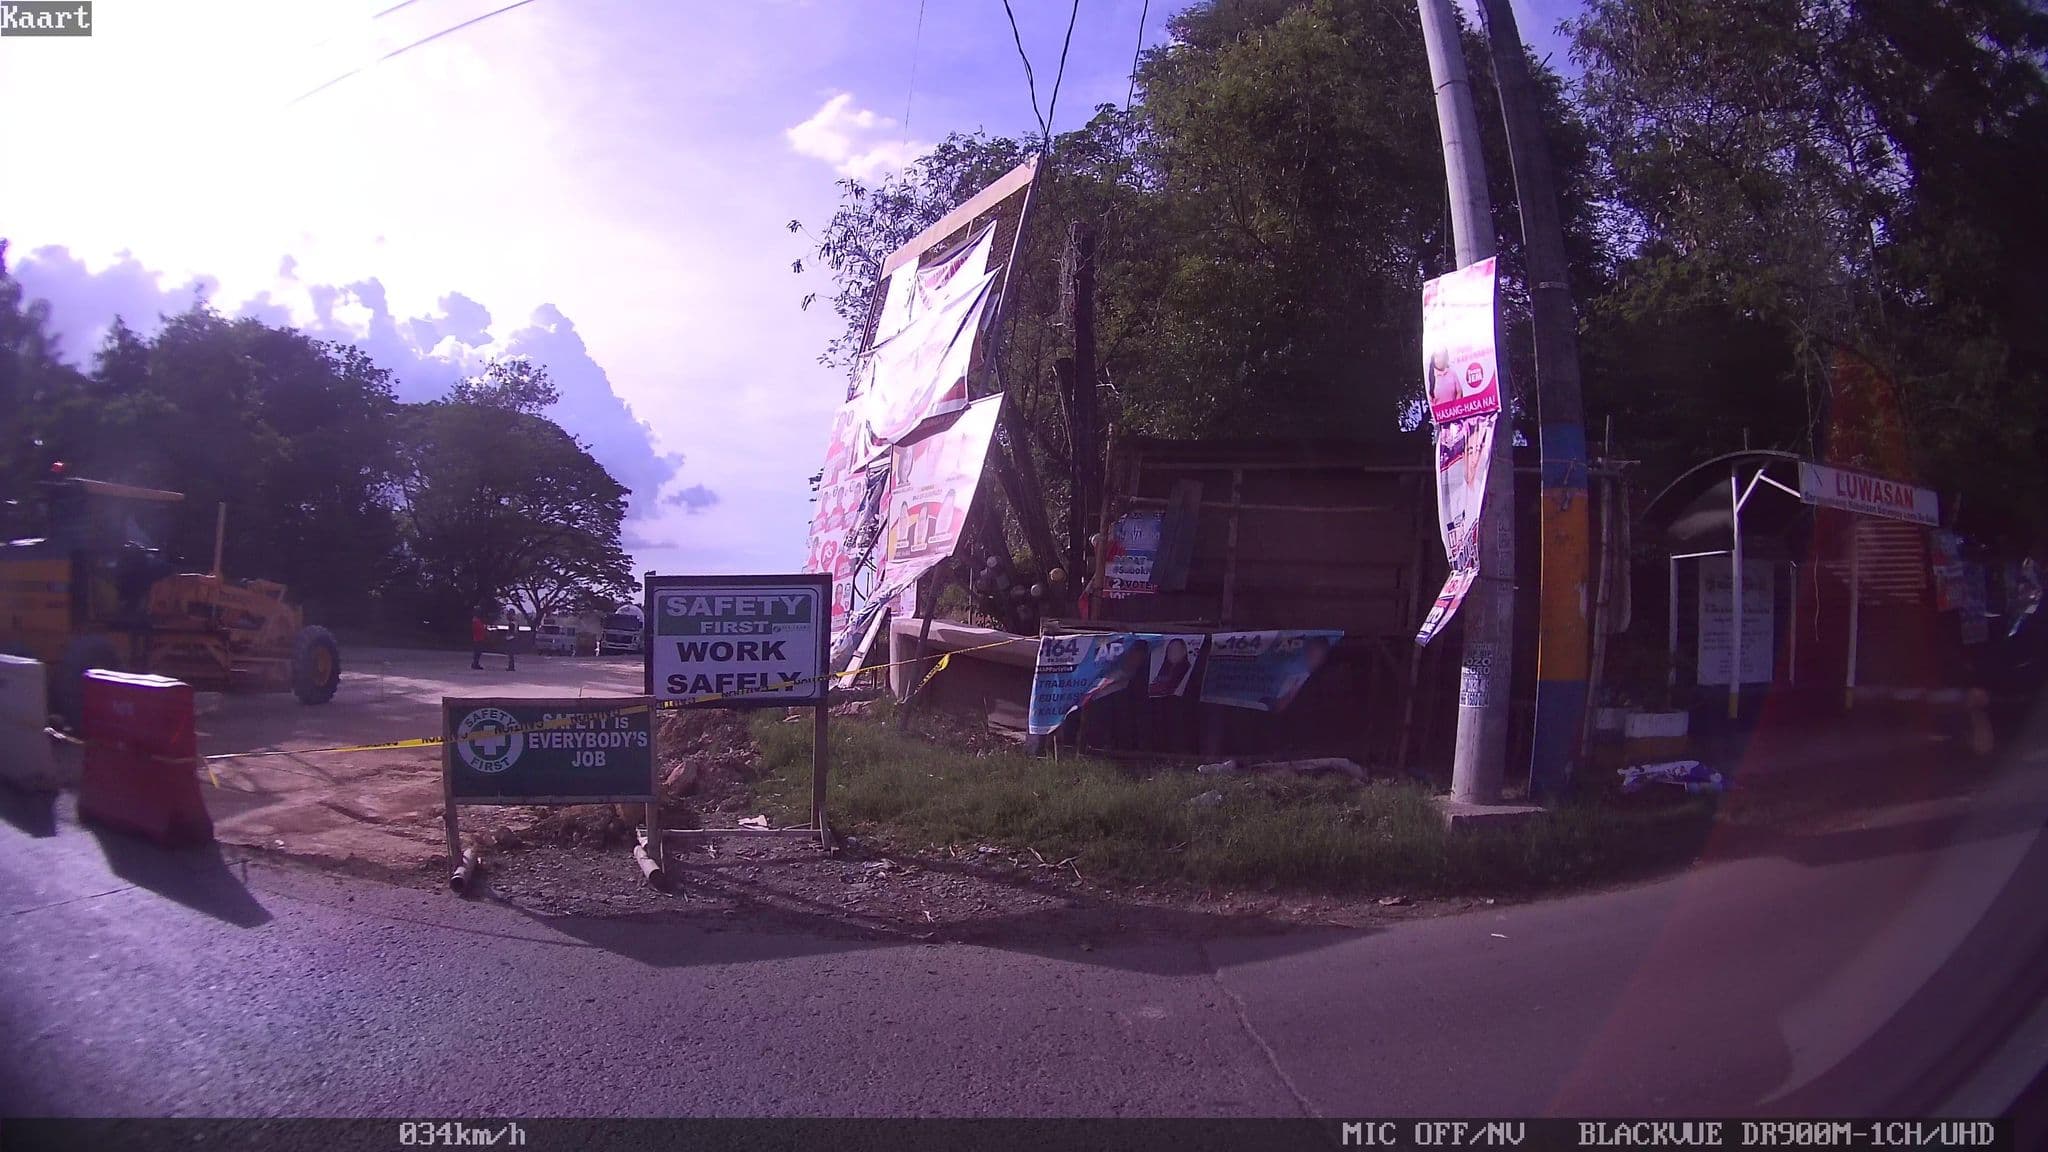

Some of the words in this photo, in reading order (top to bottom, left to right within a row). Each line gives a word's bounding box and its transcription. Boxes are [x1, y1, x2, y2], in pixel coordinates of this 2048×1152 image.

[1835, 472, 1914, 509] LUWASAN
[666, 596, 805, 617] SAFETY
[700, 621, 769, 634] FIRST
[676, 640, 786, 662] WORK
[1043, 638, 1079, 657] 164
[1464, 657, 1491, 666] OZO
[1462, 666, 1490, 675] EGRO
[667, 672, 802, 695] SAFELY
[1039, 678, 1087, 688] TRABAHO
[465, 709, 516, 728] SAFETY
[615, 717, 629, 730] IS
[529, 731, 648, 749] EVERYBODY'S
[470, 756, 511, 772] FIRST
[571, 751, 606, 767] JOB
